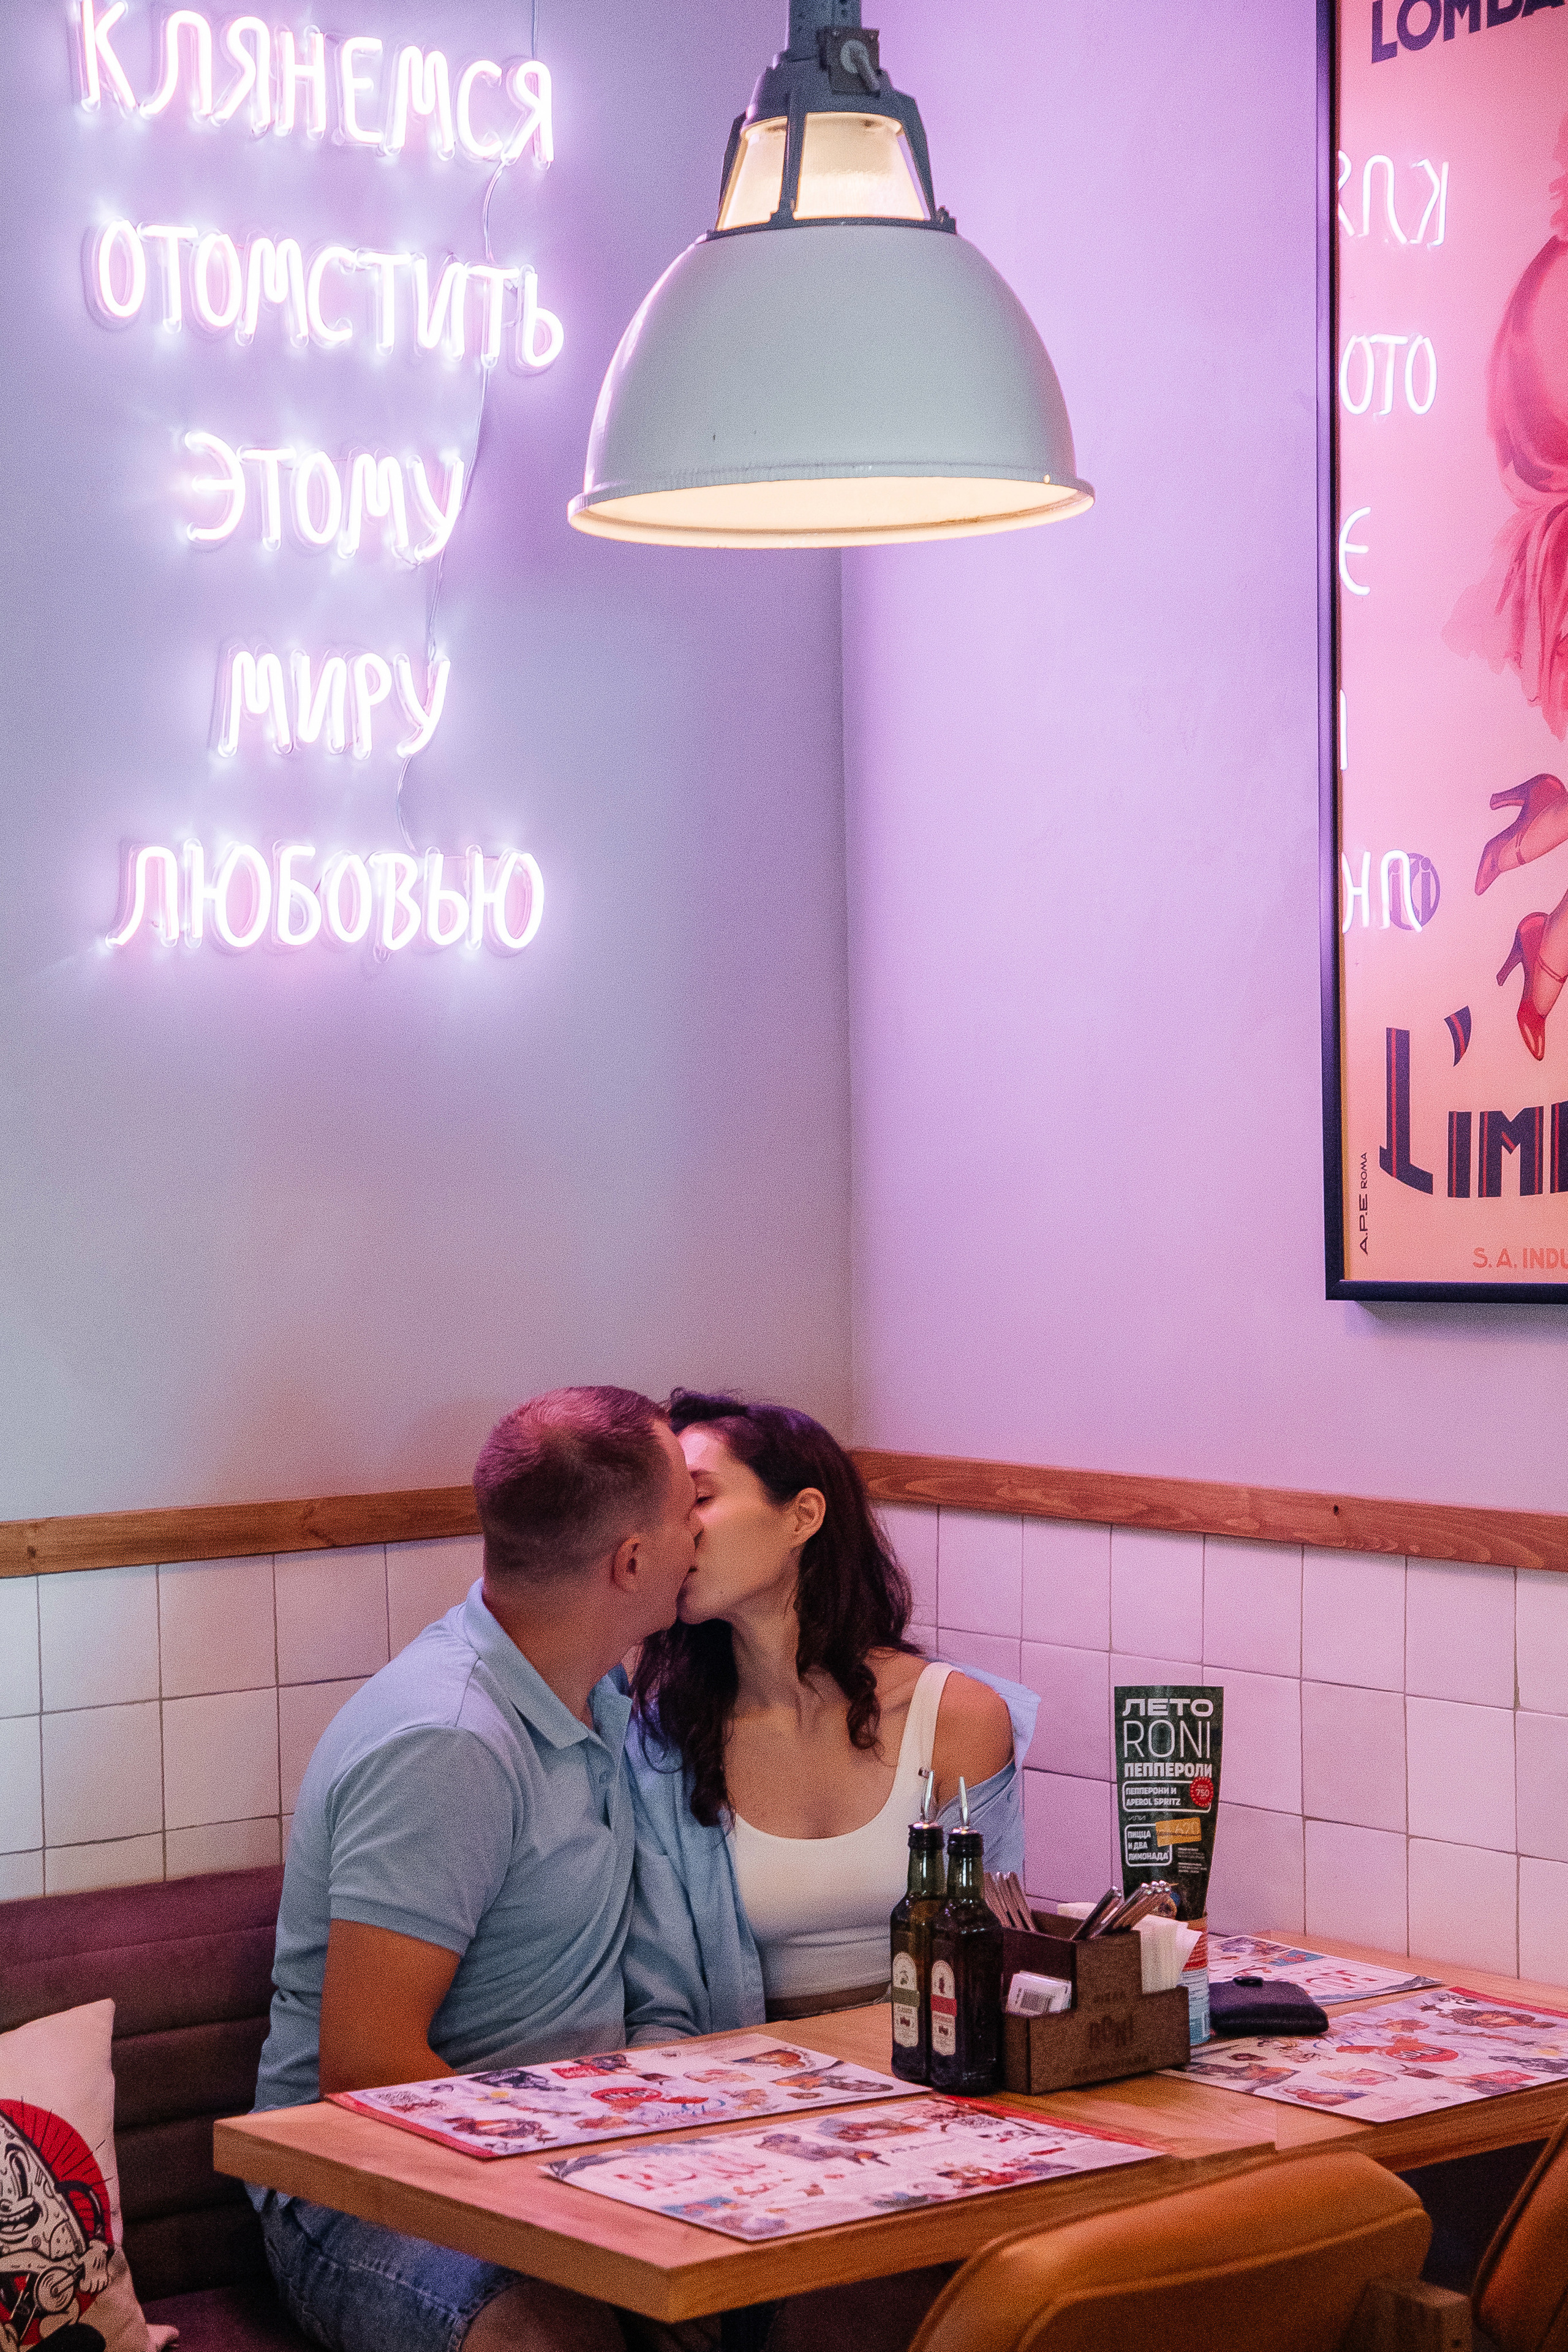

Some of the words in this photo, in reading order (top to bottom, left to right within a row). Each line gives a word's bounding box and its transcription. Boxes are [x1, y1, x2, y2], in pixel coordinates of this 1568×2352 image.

[78, 0, 555, 168] КЛЯНЕМСЯ
[96, 219, 564, 369] ОТОМСТИТЬ
[184, 431, 466, 562] ЭТОМУ
[217, 646, 451, 760] МИРУ
[104, 838, 545, 953] ЛЮБОВЬЮ
[1122, 1698, 1214, 1717] ЛЕТО
[1123, 1719, 1210, 1758] RONI
[1124, 1762, 1213, 1778] ПЕППЕРОЛИ
[1126, 1787, 1170, 1795] ПЕППЕРОНИ
[1126, 1798, 1153, 1806] APEROL
[1154, 1798, 1182, 1806] SPRITZ
[1128, 1830, 1152, 1839] ПИЦЦА
[1133, 1841, 1148, 1850] ДВА
